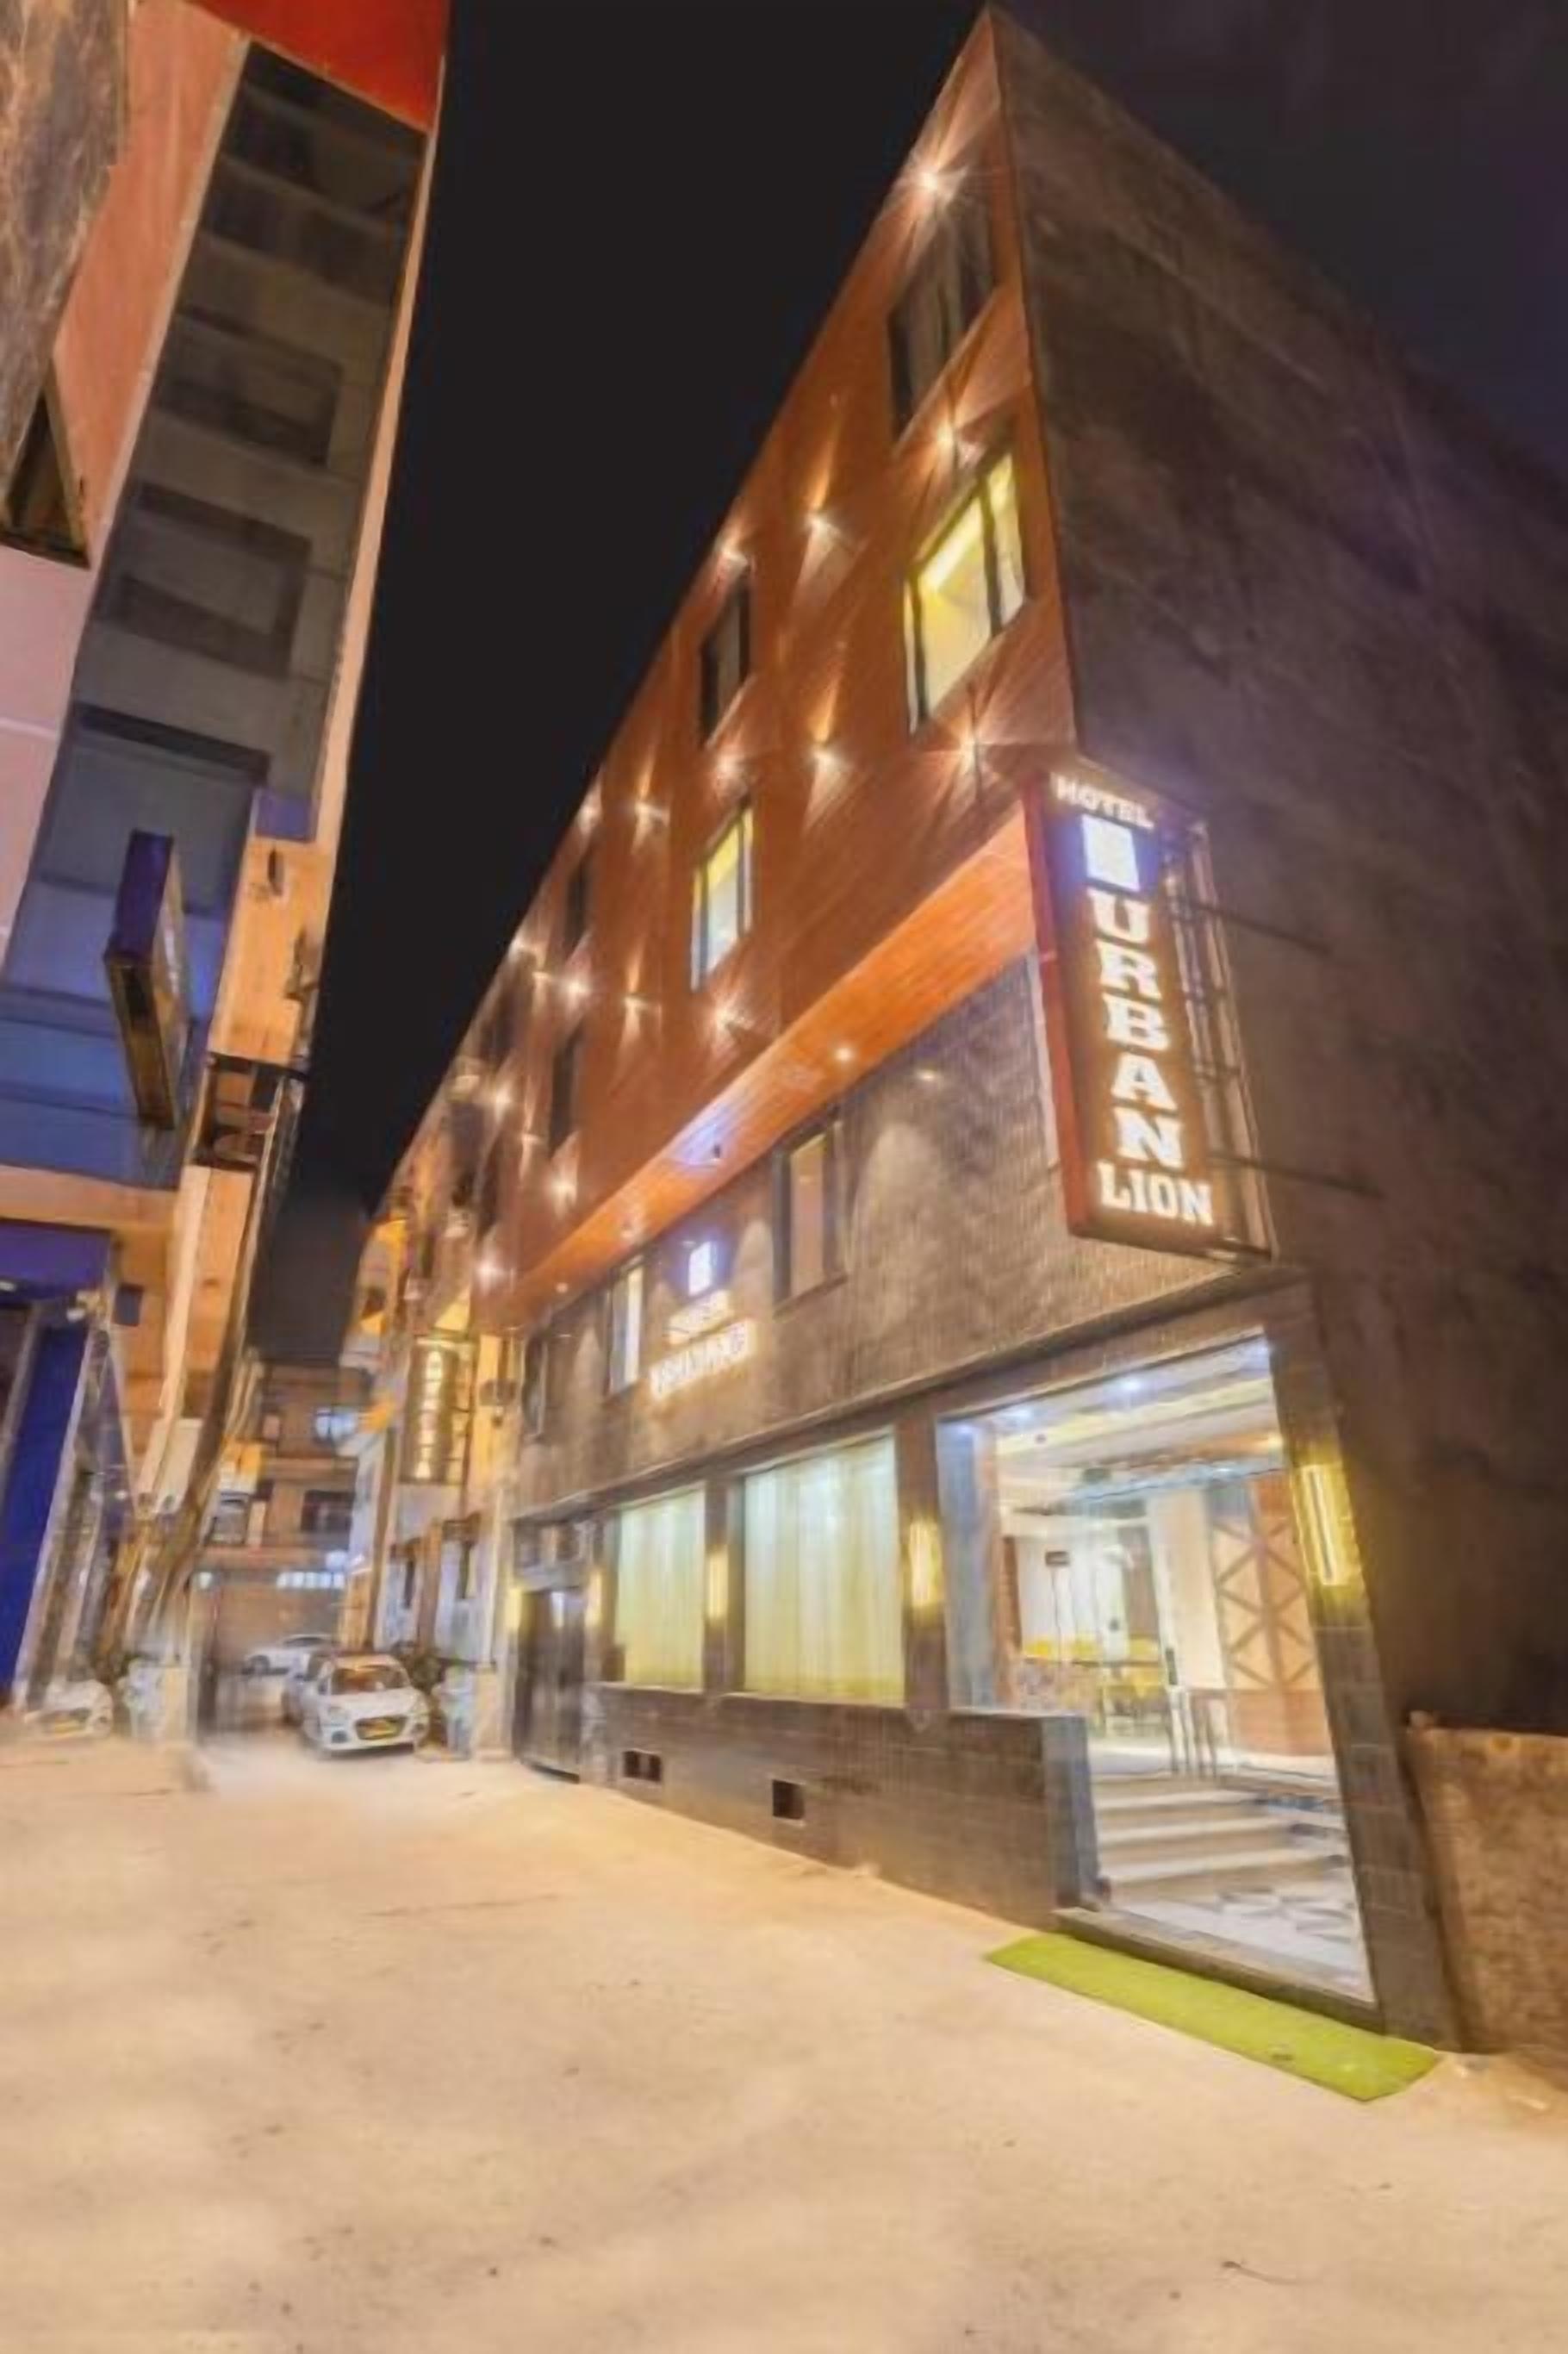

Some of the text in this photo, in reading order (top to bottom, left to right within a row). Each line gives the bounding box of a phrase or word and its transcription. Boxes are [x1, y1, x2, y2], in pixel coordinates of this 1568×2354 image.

[1052, 774, 1154, 829] HOTEL
[1089, 890, 1184, 1168] URBAN
[1098, 1161, 1213, 1226] LION
